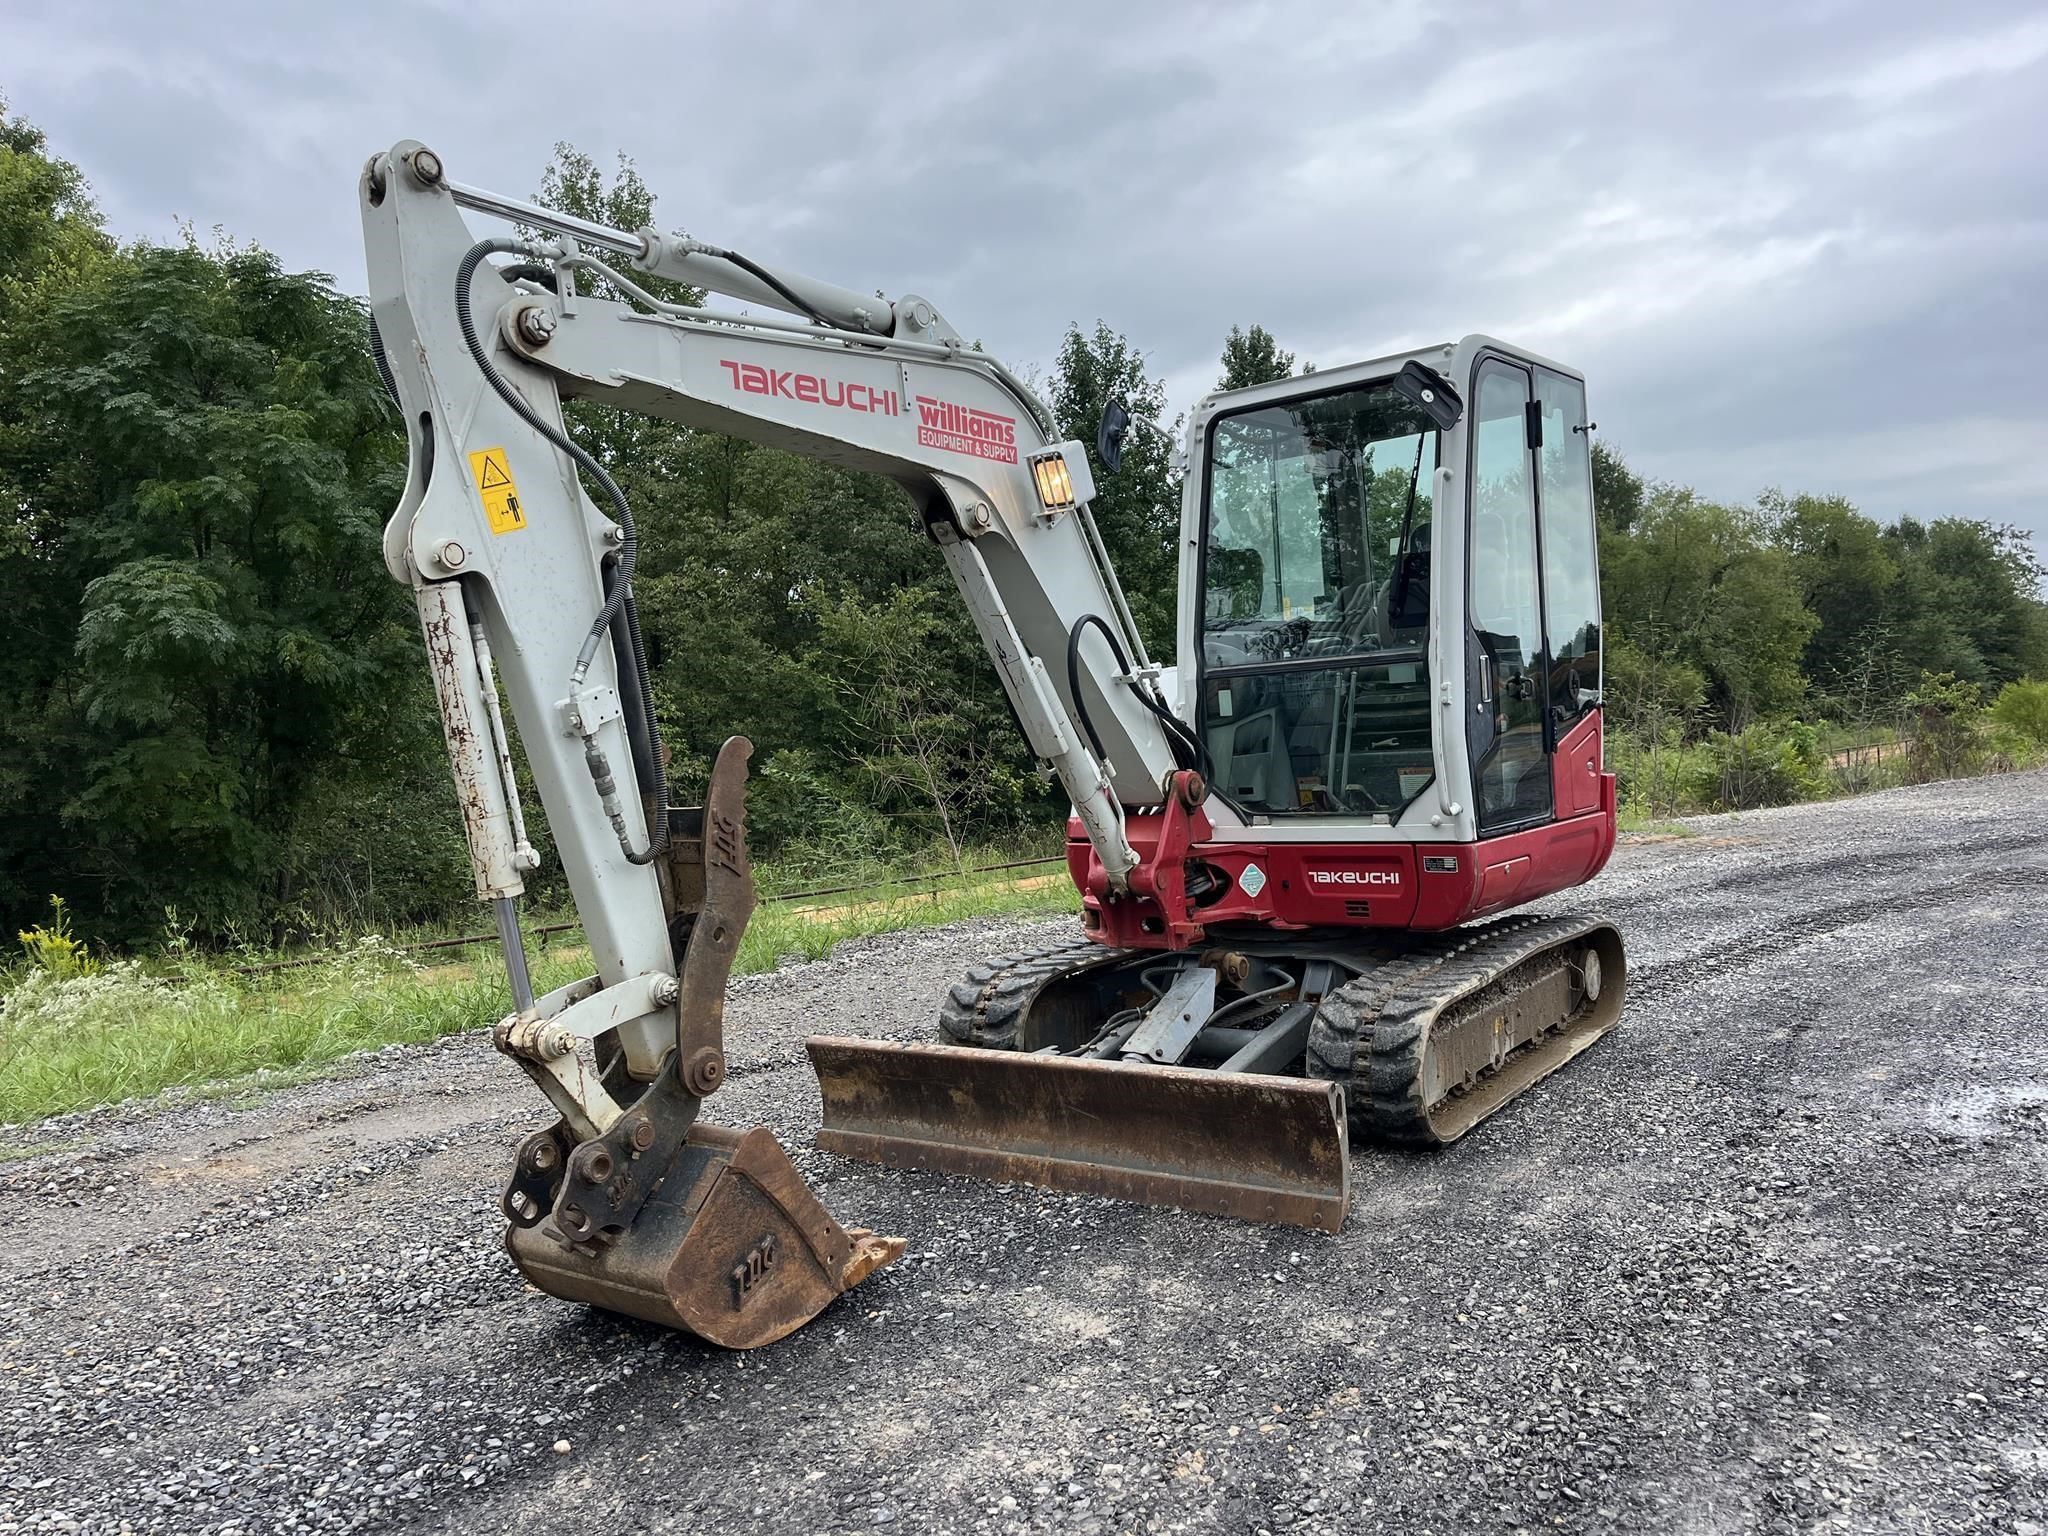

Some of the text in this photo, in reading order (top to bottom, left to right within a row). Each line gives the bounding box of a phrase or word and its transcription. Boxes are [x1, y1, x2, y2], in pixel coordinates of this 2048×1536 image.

[920, 429, 1016, 463] EQUIPMENT & SUPPLY
